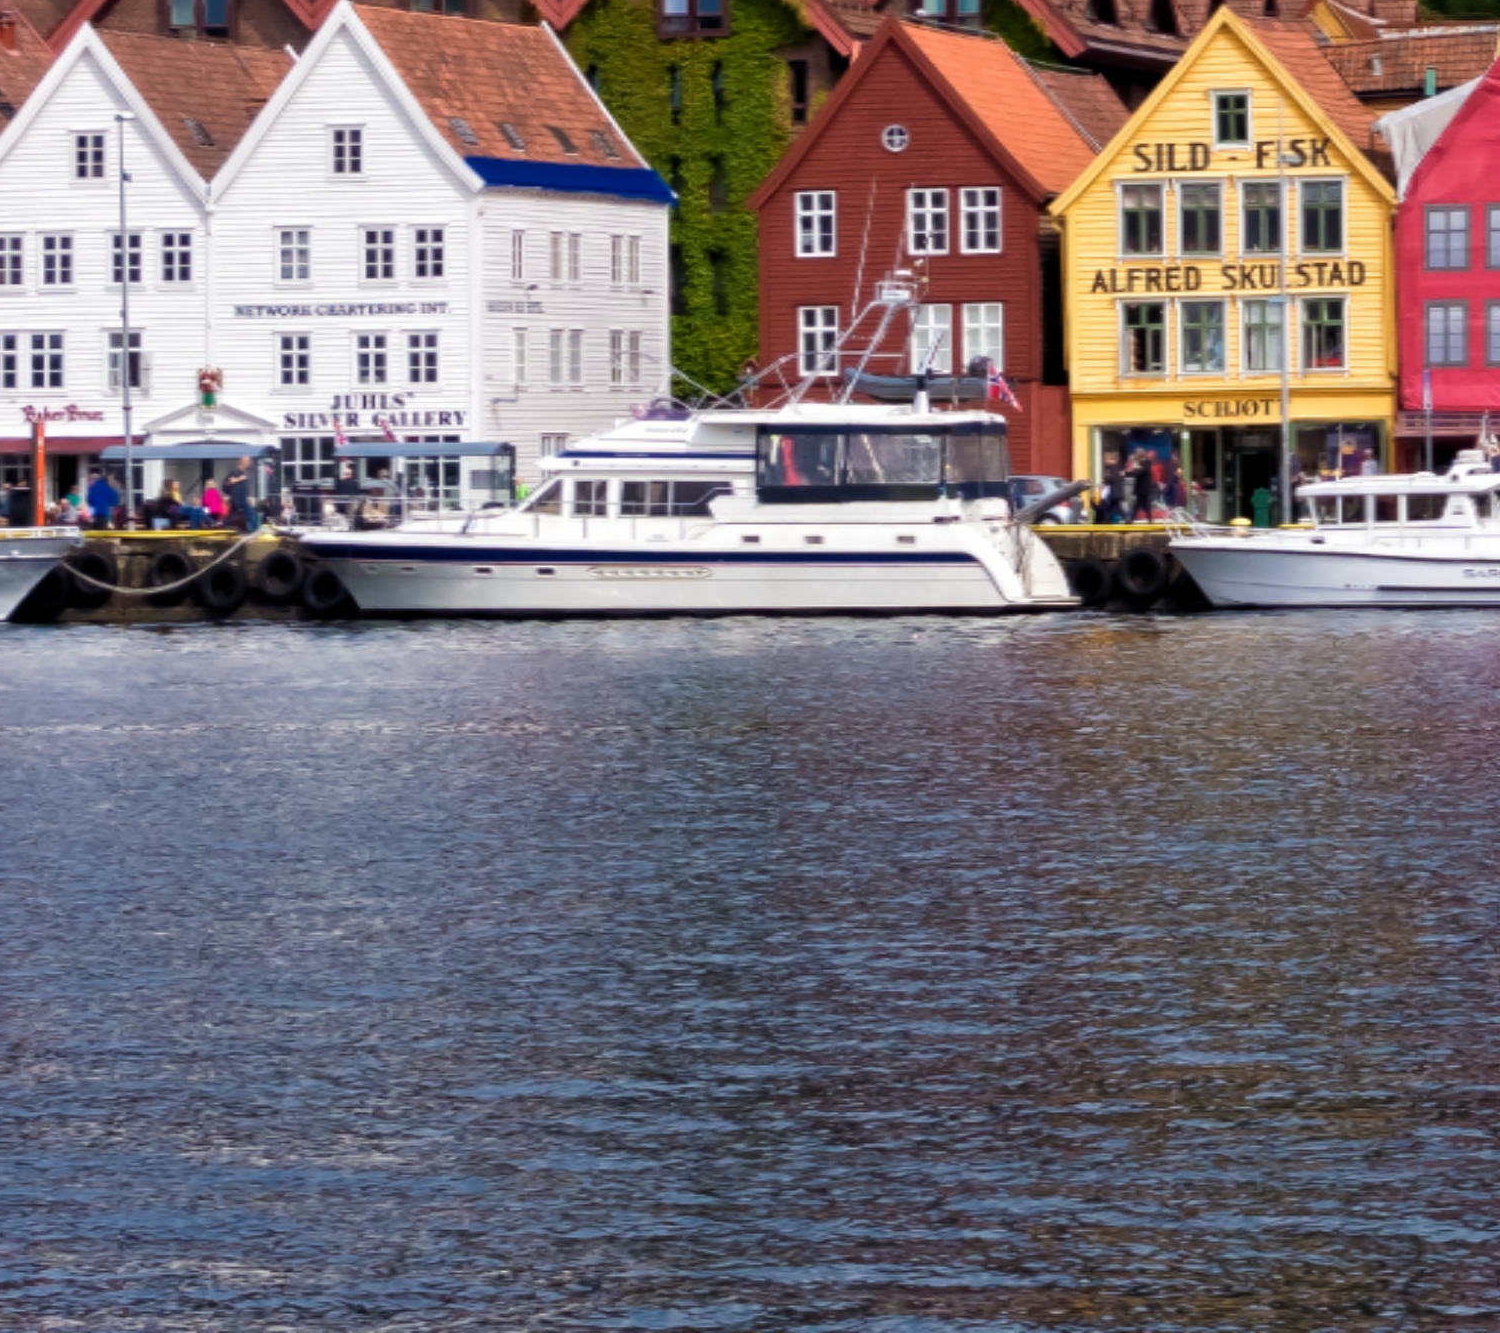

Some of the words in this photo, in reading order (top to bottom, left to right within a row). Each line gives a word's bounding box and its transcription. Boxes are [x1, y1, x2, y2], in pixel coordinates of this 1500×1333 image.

[1132, 142, 1211, 172] SILD
[1255, 137, 1332, 169] FISK
[1091, 265, 1202, 293] ALFRED
[234, 304, 312, 317] NETWORK
[316, 303, 416, 317] CHARTERING
[284, 412, 359, 429] SILVER
[372, 410, 466, 427] GALLERY
